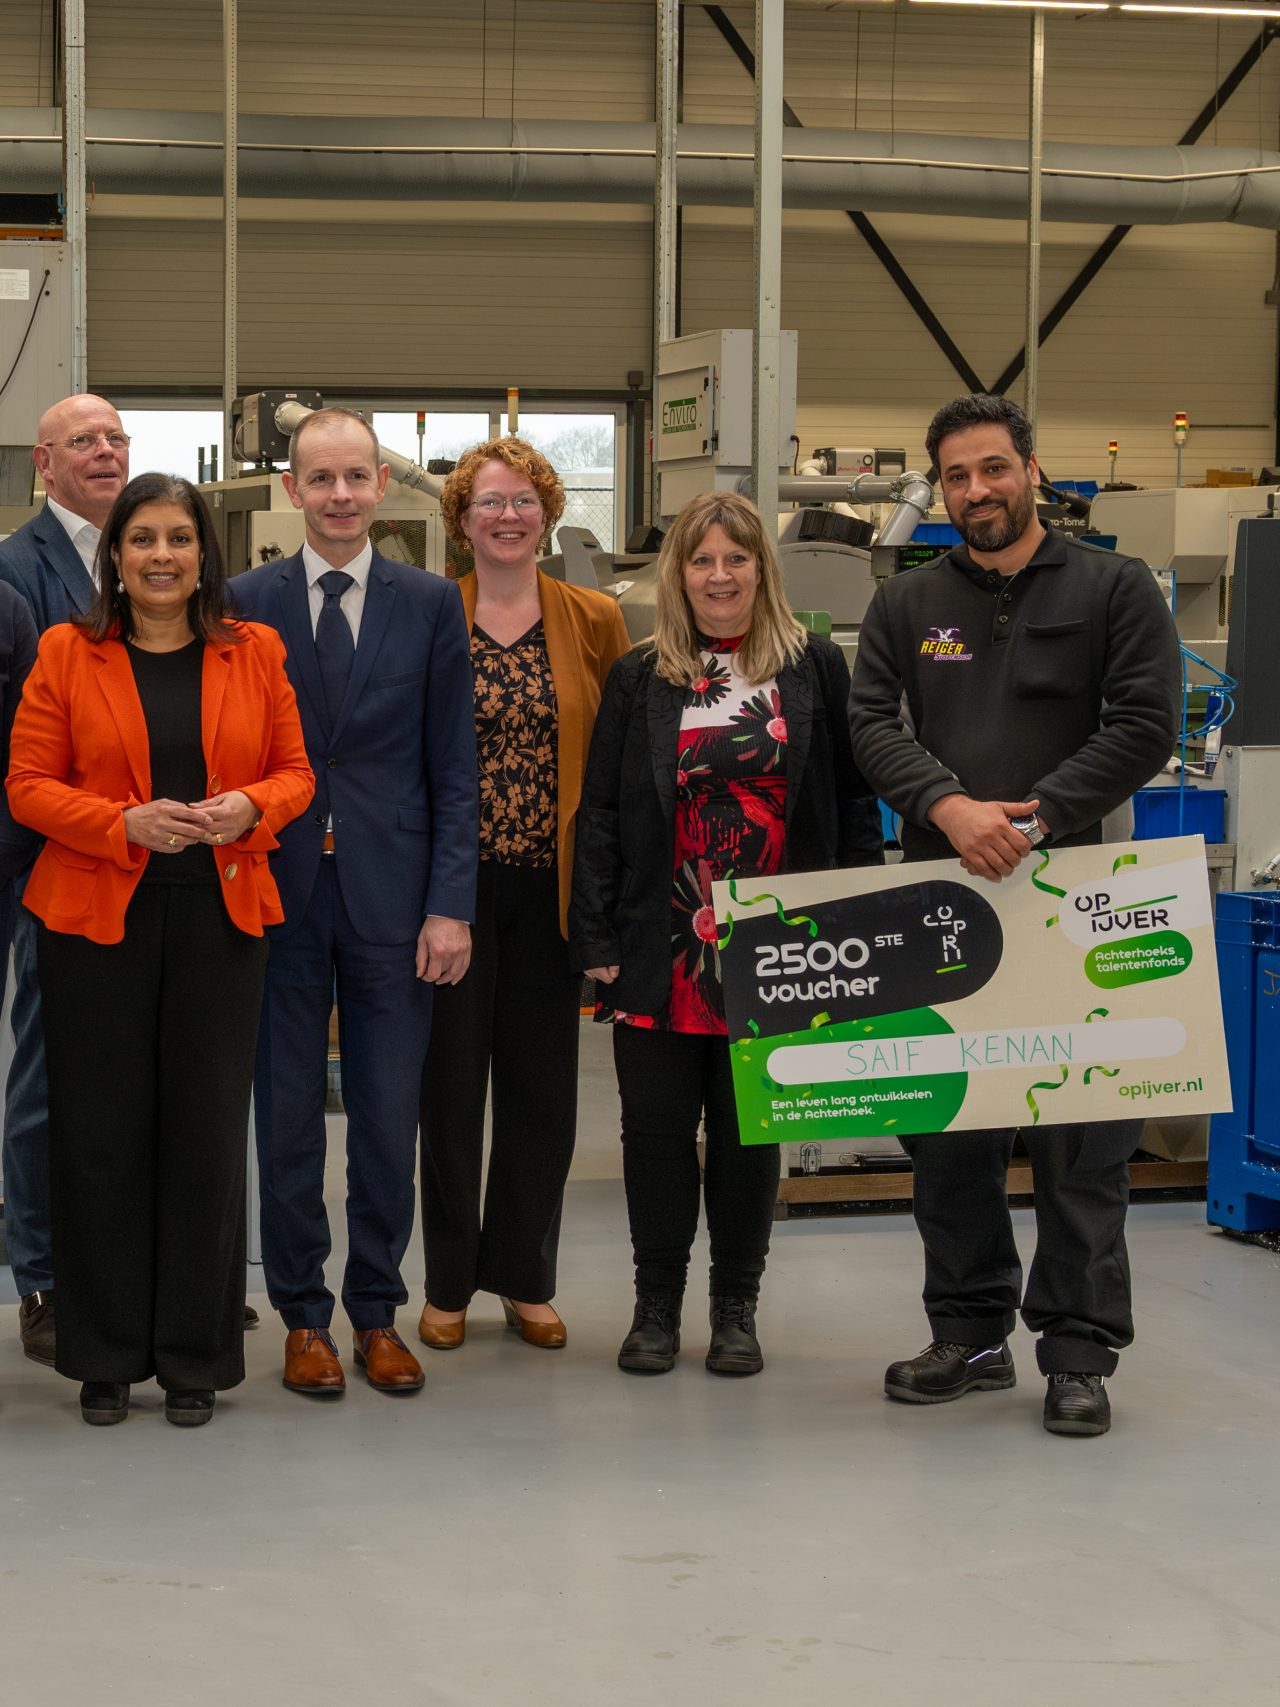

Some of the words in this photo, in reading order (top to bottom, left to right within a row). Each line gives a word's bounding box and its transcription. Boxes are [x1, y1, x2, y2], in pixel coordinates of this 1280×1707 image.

[662, 400, 697, 427] Enviro
[920, 641, 964, 655] REIGER
[1075, 893, 1111, 912] OP
[1091, 908, 1170, 933] IJVER
[755, 937, 870, 977] 2500
[874, 933, 904, 948] STE
[1095, 945, 1176, 962] Achterhoeks
[1096, 956, 1186, 973] talentenfonds
[758, 973, 880, 1004] voucher
[846, 1040, 923, 1075] SAIF
[960, 1032, 1072, 1067] KENAN
[1119, 1077, 1203, 1100] opijver.nl
[771, 1100, 793, 1110] Een
[796, 1097, 828, 1108] leven
[830, 1095, 856, 1106] lang
[859, 1090, 933, 1104] ontwikkelen
[772, 1111, 784, 1122] in
[786, 1110, 801, 1121] de
[804, 1106, 876, 1120] Achterhoek.
